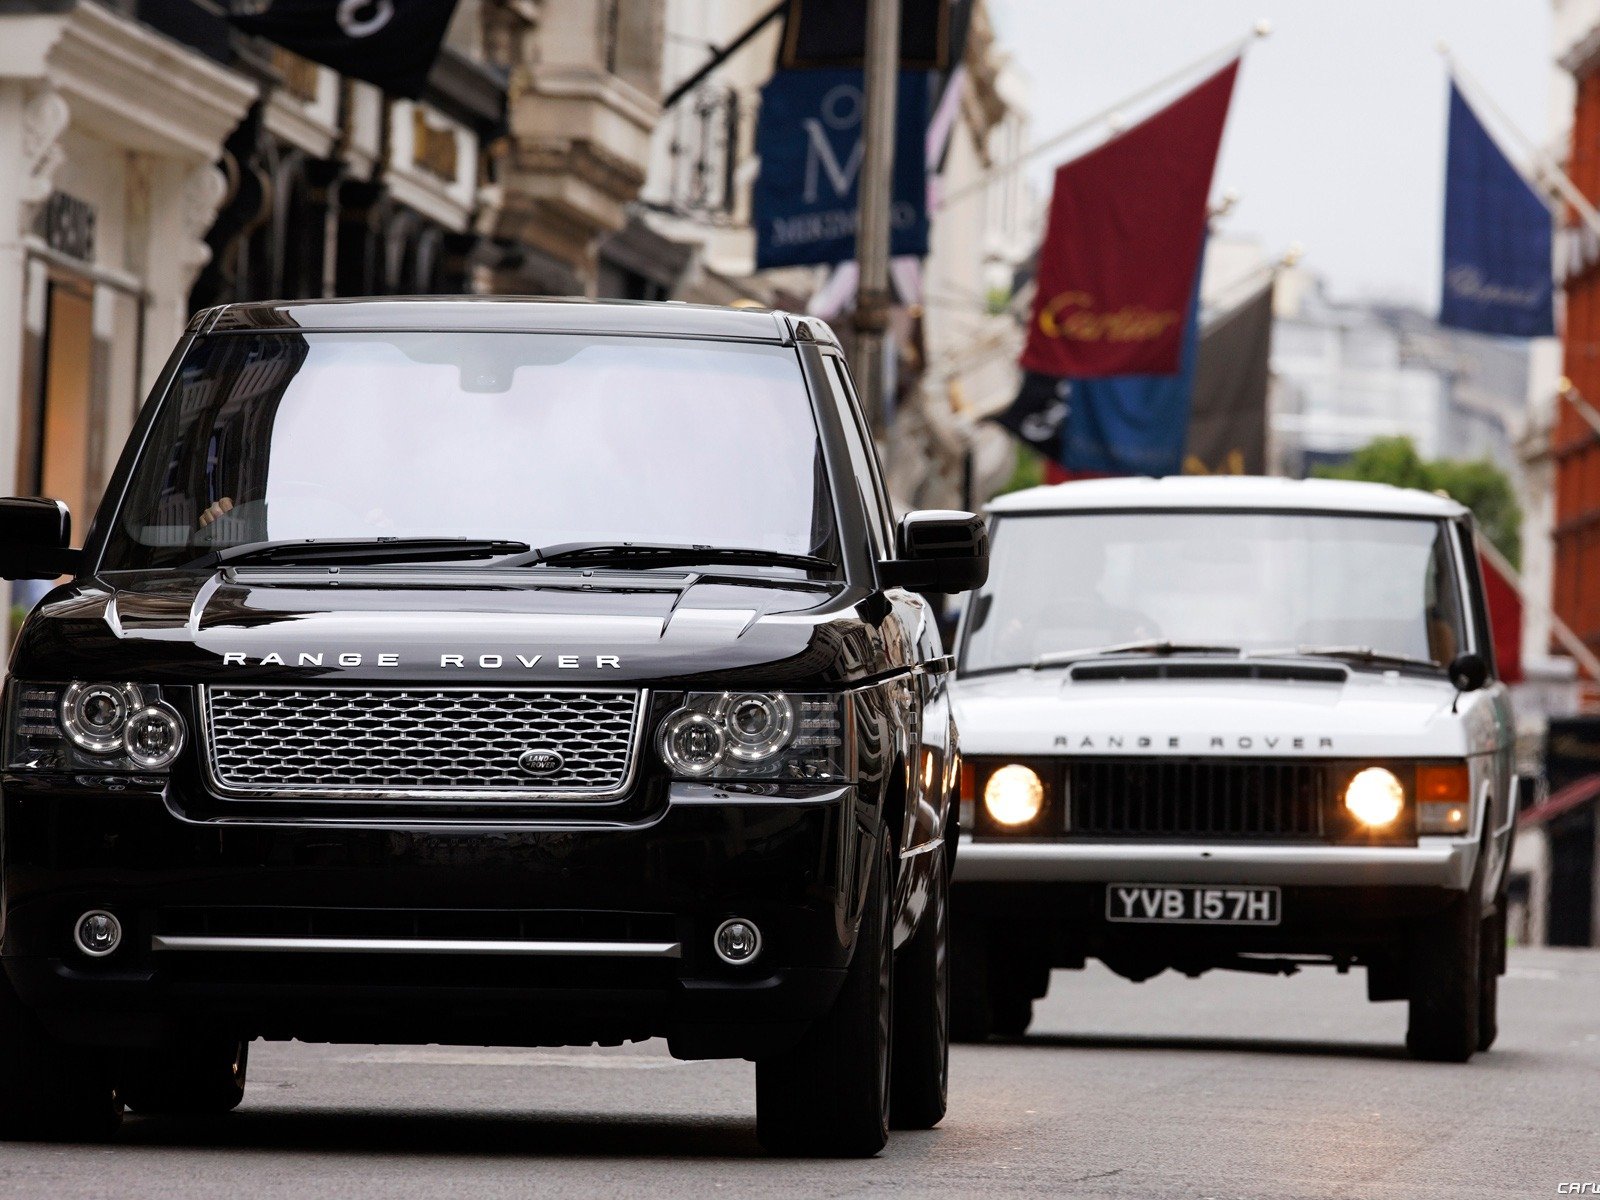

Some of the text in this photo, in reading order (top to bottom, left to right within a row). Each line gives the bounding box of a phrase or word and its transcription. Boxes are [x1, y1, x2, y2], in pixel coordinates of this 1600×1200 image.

[222, 652, 622, 669] RANGE ROVER
[1053, 735, 1334, 749] RANGE ROVER
[1118, 889, 1270, 920] YVB 157H
